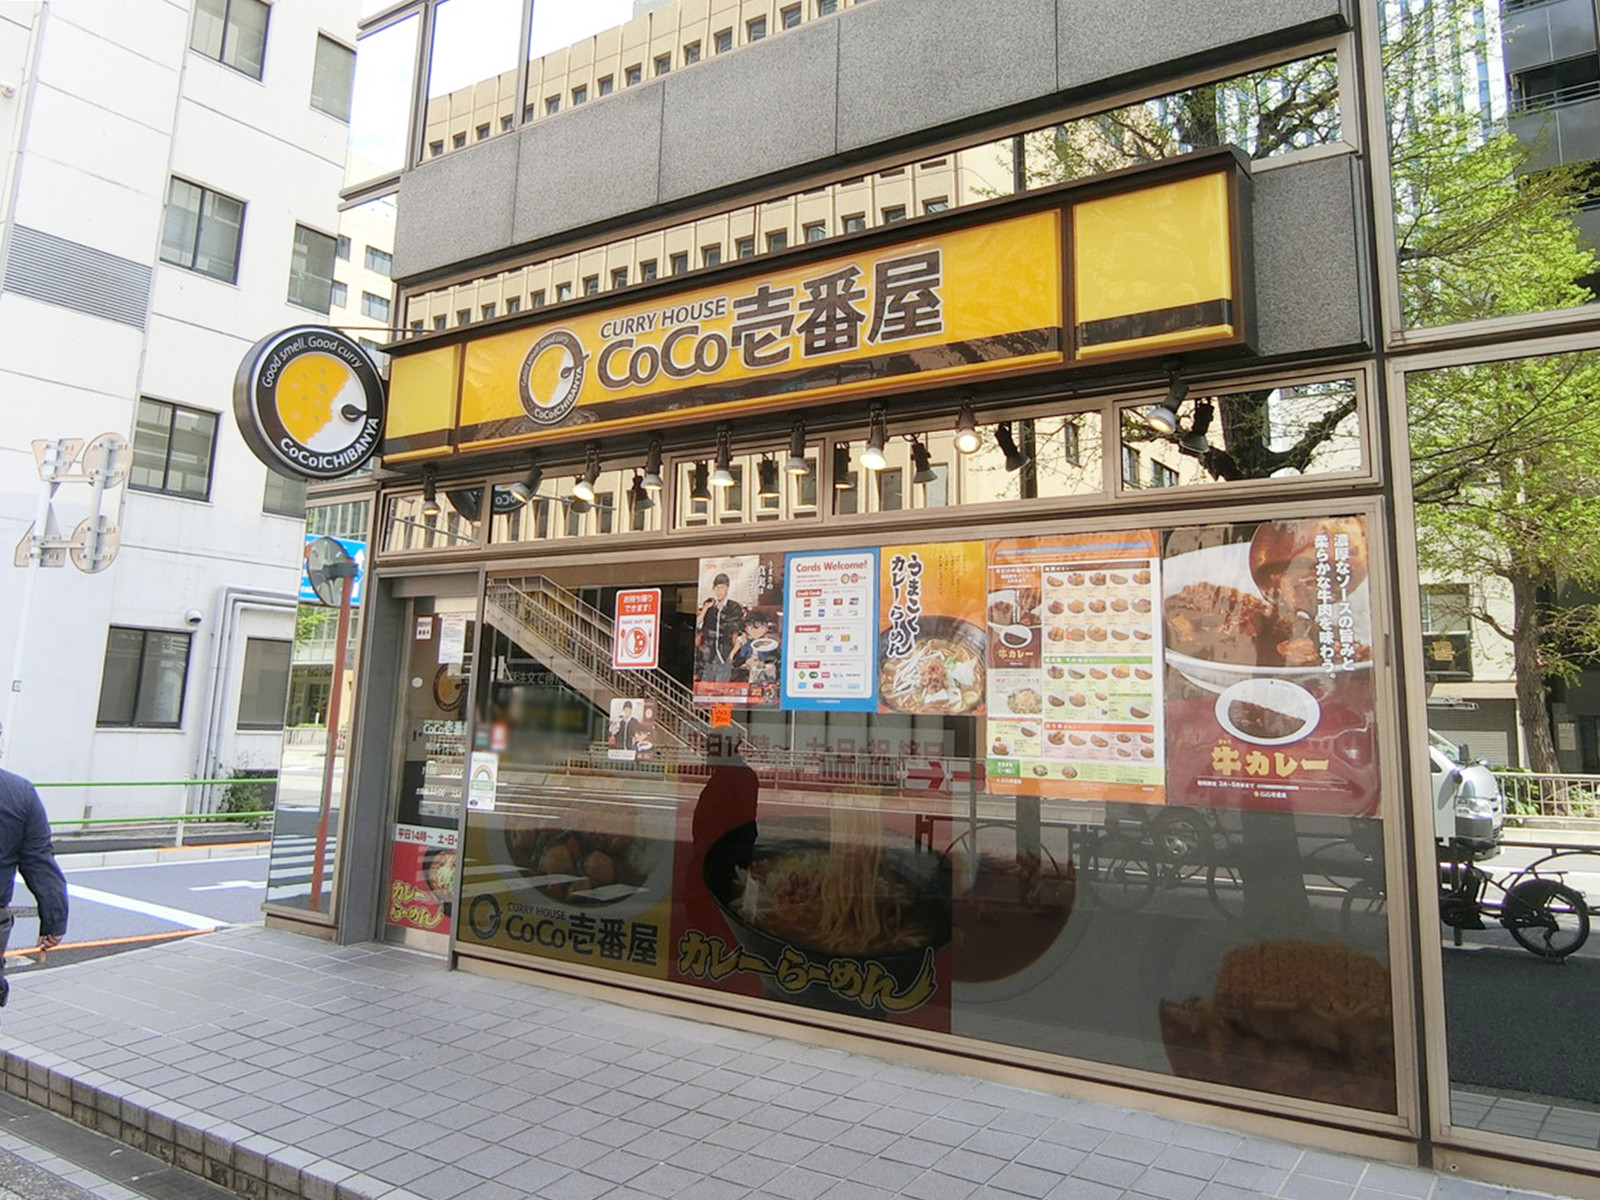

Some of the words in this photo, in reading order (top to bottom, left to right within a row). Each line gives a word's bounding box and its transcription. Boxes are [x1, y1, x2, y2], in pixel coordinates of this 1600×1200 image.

[600, 312, 656, 342] CURRY
[660, 297, 727, 330] HOUSE
[262, 355, 282, 389] Good
[308, 336, 339, 352] Good
[337, 346, 363, 370] curry
[280, 418, 380, 469] CoCoICHIBANYA
[796, 562, 822, 573] Cards
[823, 559, 868, 572] Welcome!
[888, 556, 915, 658] カレーらーめん
[907, 554, 924, 634] うまこく
[1210, 746, 1330, 778] 牛カレー
[507, 902, 535, 915] CURRY
[536, 905, 567, 921] HOUSE
[677, 929, 939, 1014] カレーらーめん
